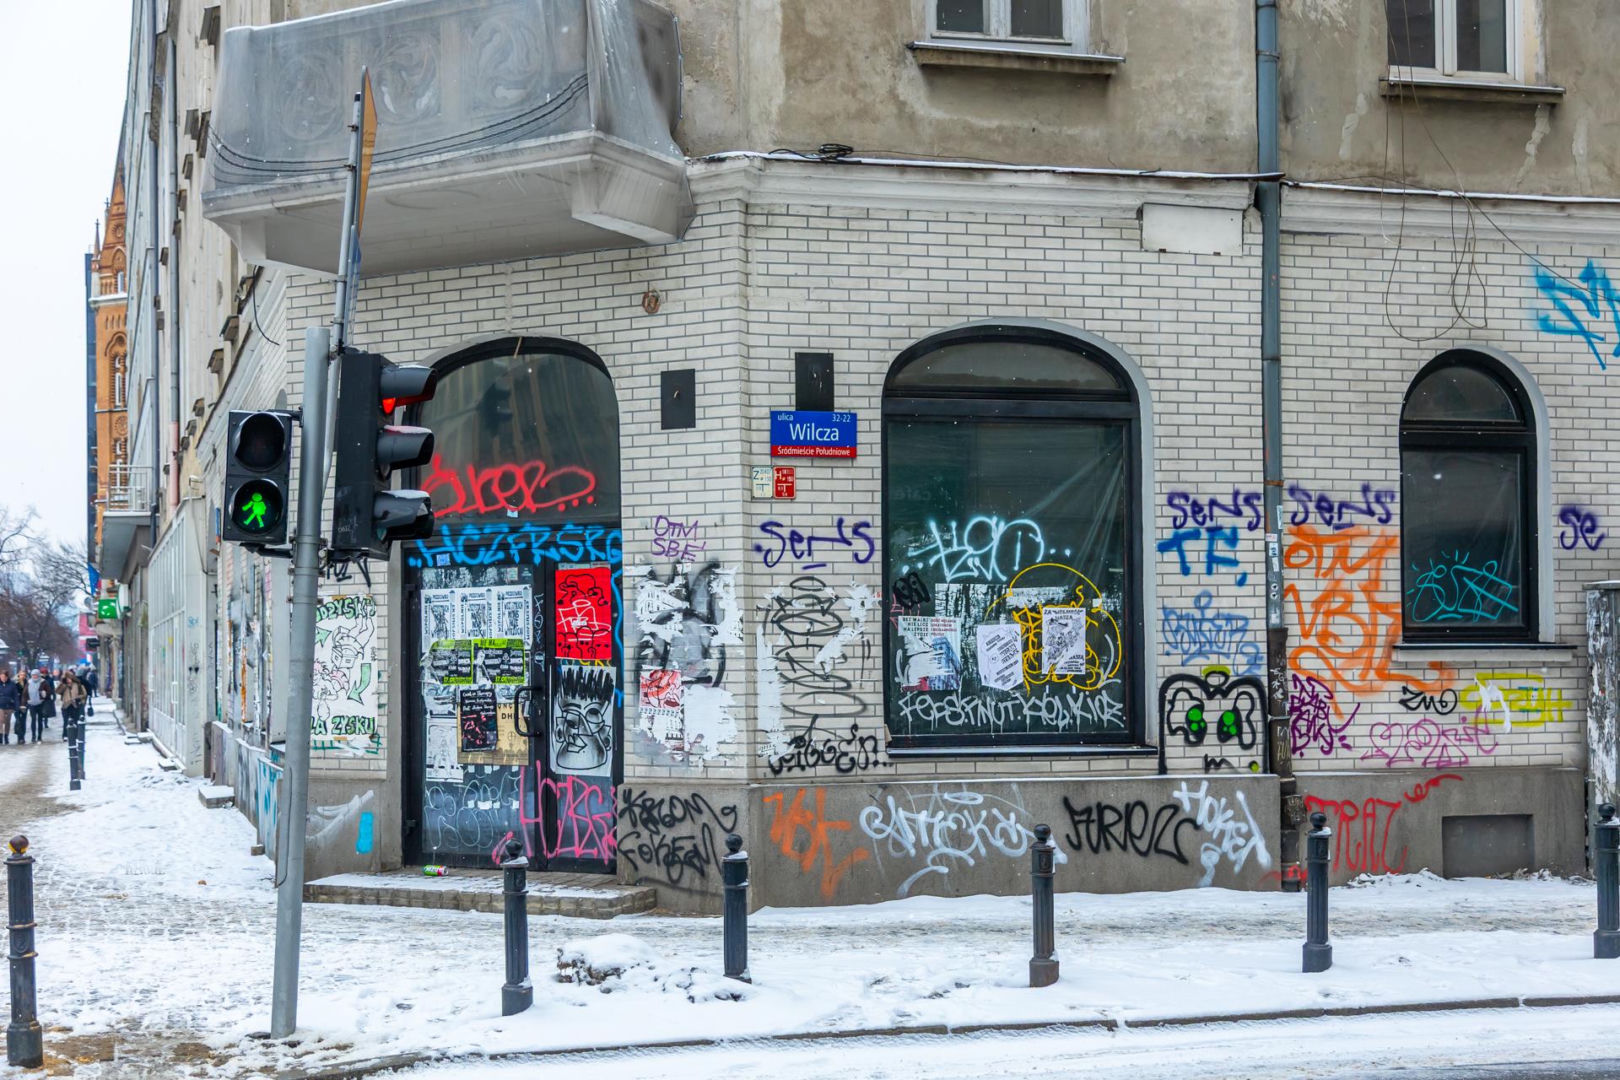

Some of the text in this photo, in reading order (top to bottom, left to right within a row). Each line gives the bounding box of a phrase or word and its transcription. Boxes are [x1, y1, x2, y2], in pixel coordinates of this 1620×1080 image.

[777, 413, 794, 421] ulica
[789, 422, 840, 441] Wilcza
[777, 445, 851, 456] Śródmieście Południowe
[311, 715, 376, 736] LA ZYSKU
